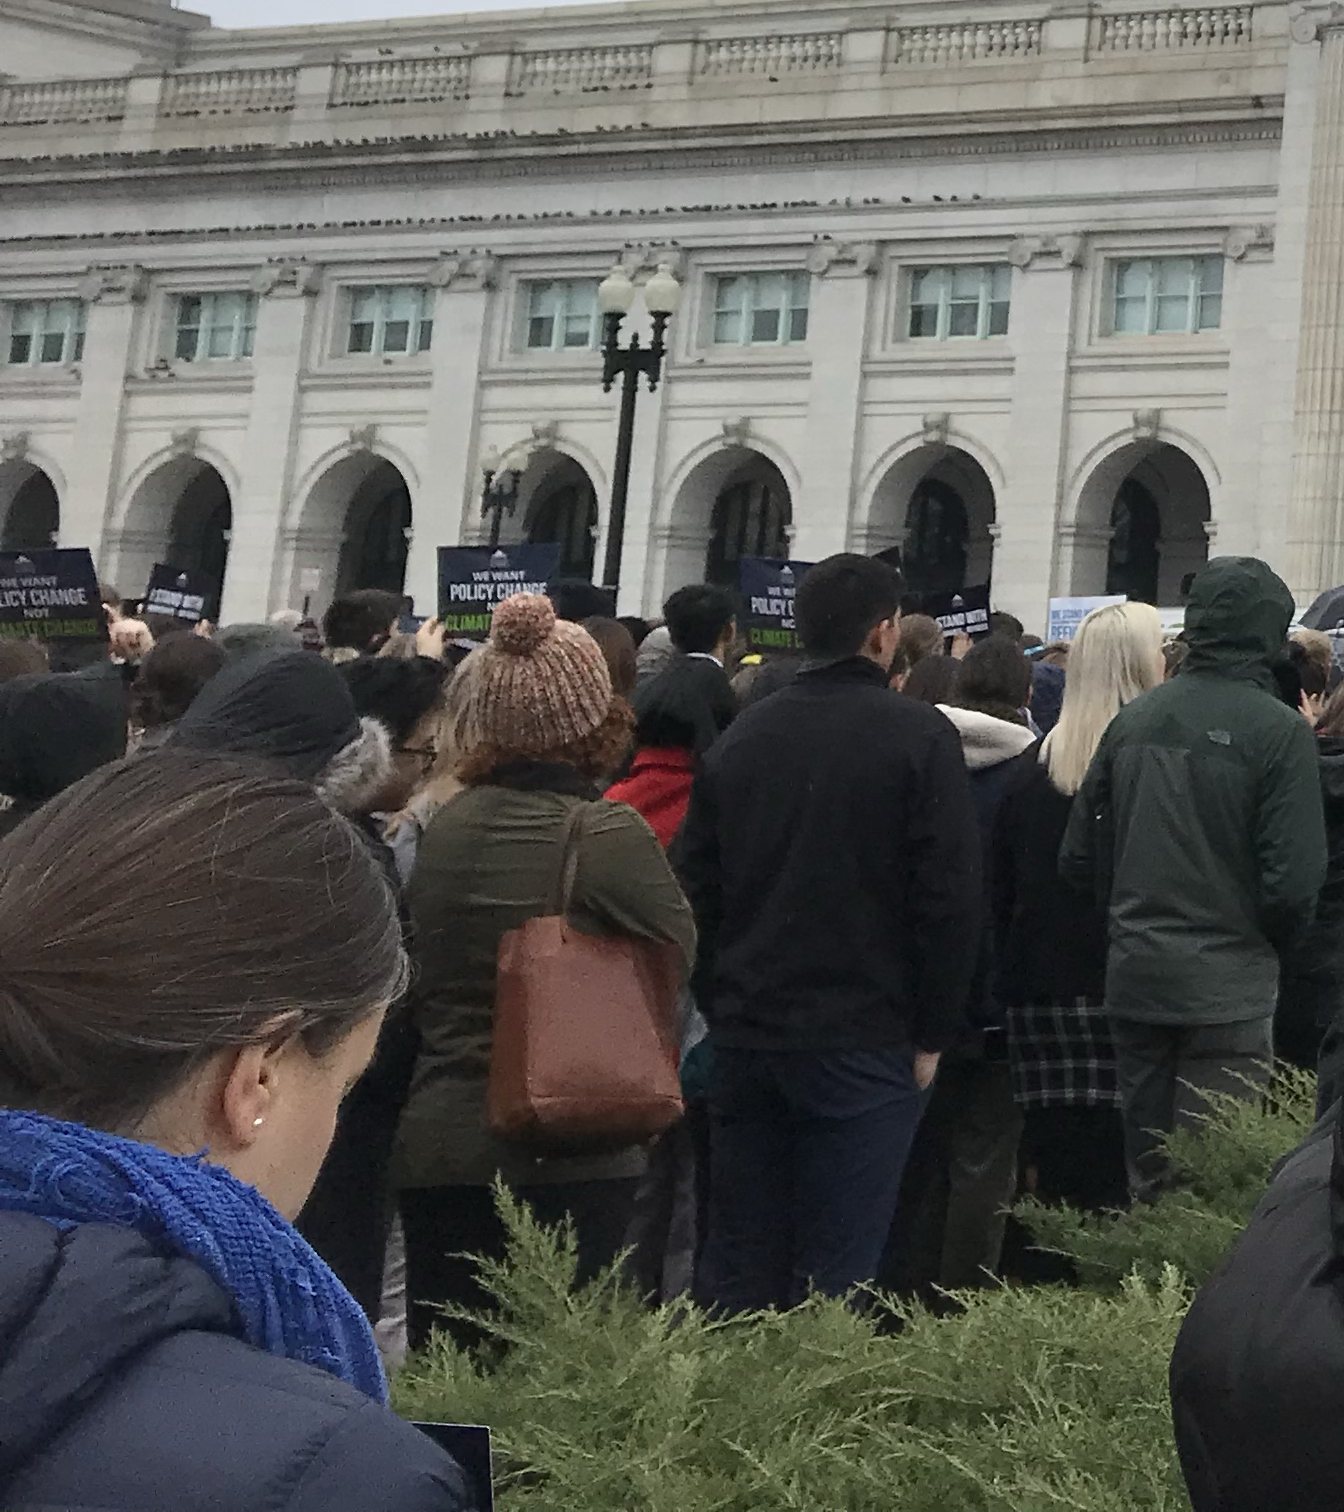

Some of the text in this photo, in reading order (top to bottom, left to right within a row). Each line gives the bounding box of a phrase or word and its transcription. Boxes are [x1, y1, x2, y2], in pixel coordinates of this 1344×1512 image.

[30, 587, 91, 607] CHANGE
[450, 583, 494, 601] POLICY
[751, 596, 789, 616] POLICY
